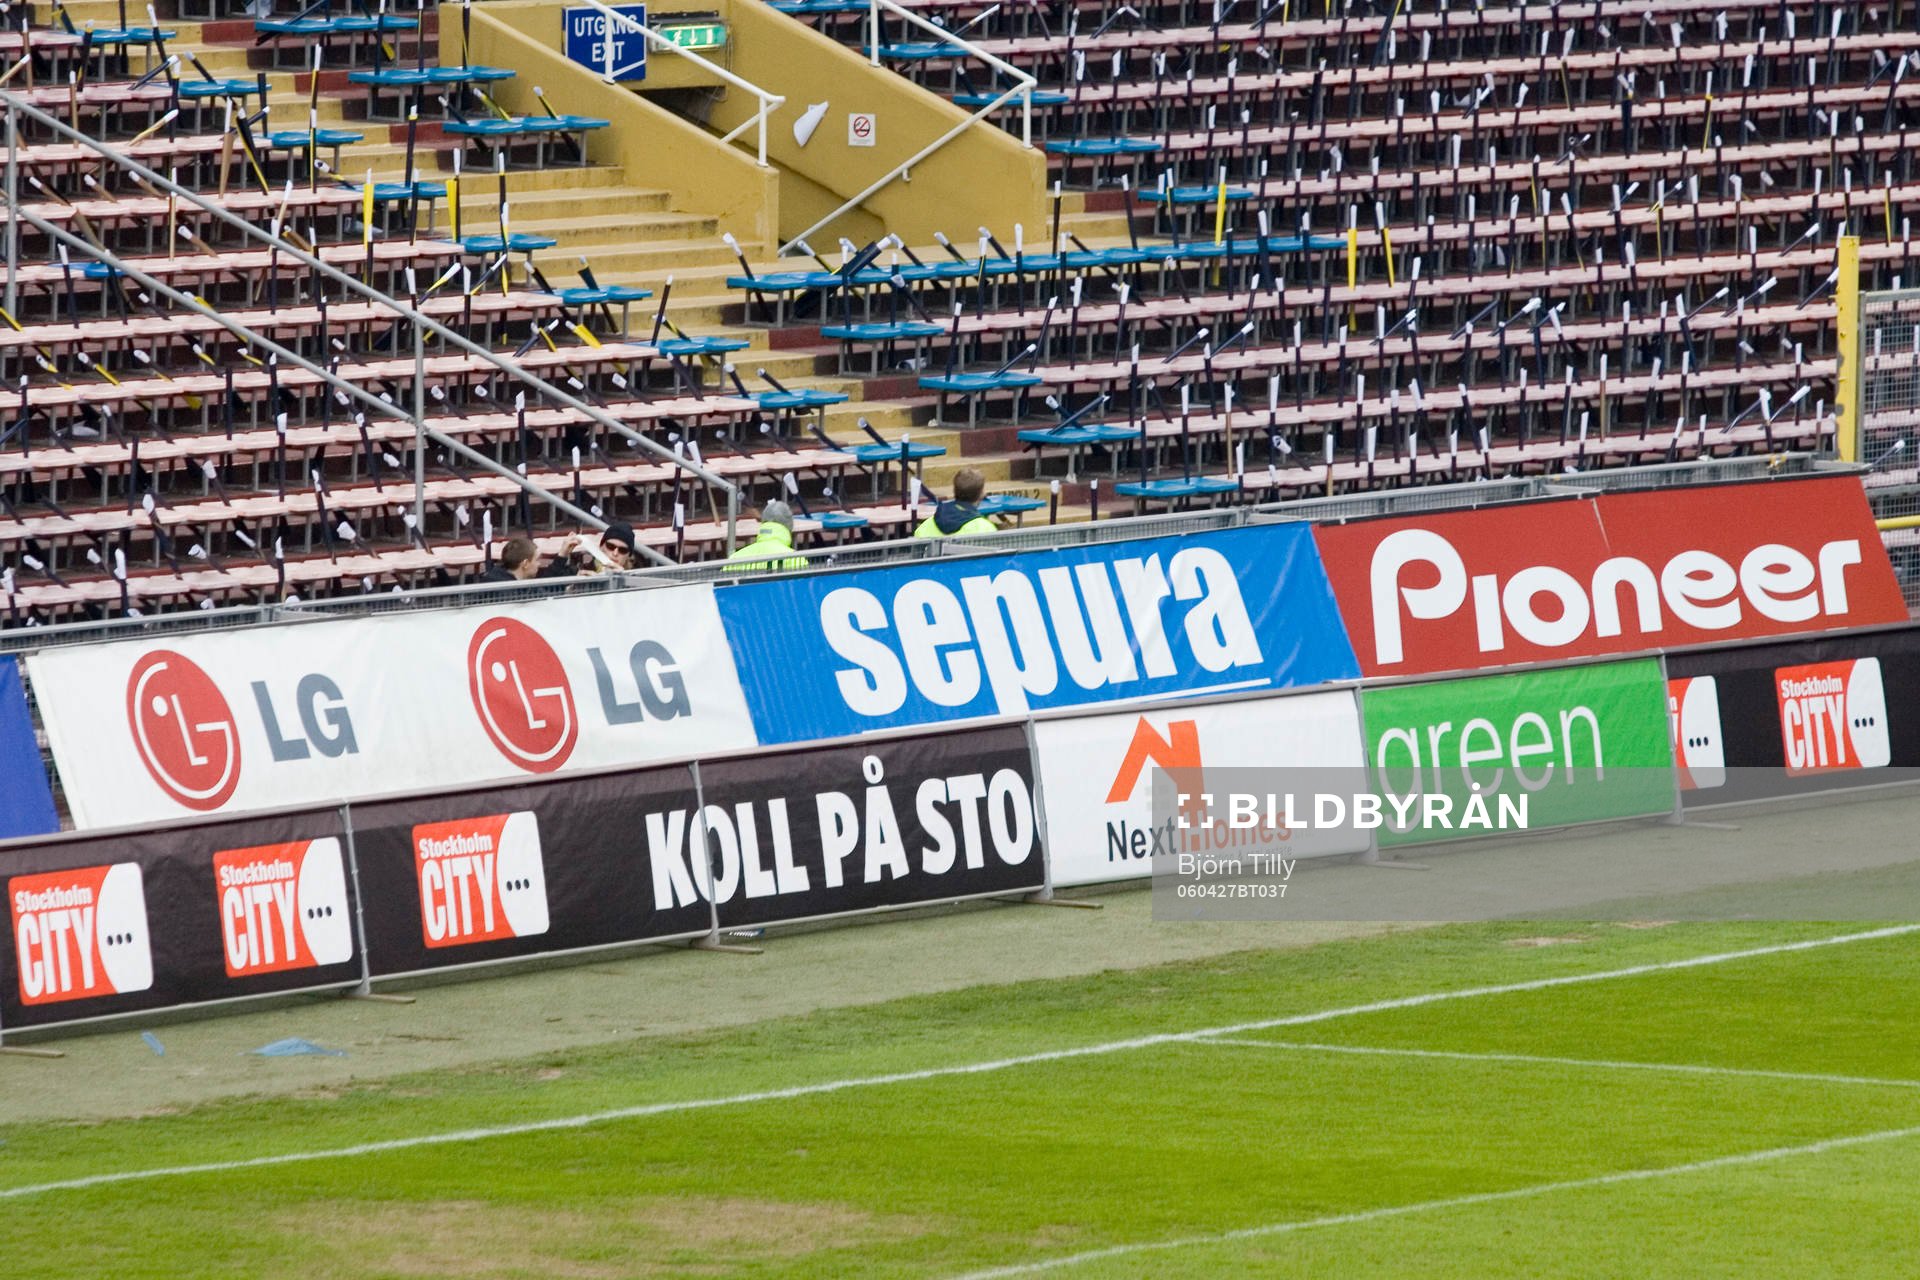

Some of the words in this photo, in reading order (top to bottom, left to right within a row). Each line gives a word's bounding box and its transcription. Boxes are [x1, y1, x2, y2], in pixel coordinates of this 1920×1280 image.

[820, 547, 1264, 715] sepura
[1371, 529, 1862, 665] Pioneer
[251, 673, 360, 763] LG
[586, 640, 691, 726] LG
[1781, 675, 1844, 699] Stockholm
[1377, 706, 1604, 834] green
[1783, 693, 1847, 771] CITY
[220, 858, 294, 887] Stockholm
[419, 831, 492, 860] Stockholm
[645, 797, 811, 912] KOLL
[816, 755, 909, 888] PÅ
[915, 768, 1042, 876] STO
[15, 884, 93, 913] Stockholm
[222, 881, 299, 970] CITY
[421, 854, 496, 942] CITY
[18, 906, 95, 998] CITY
